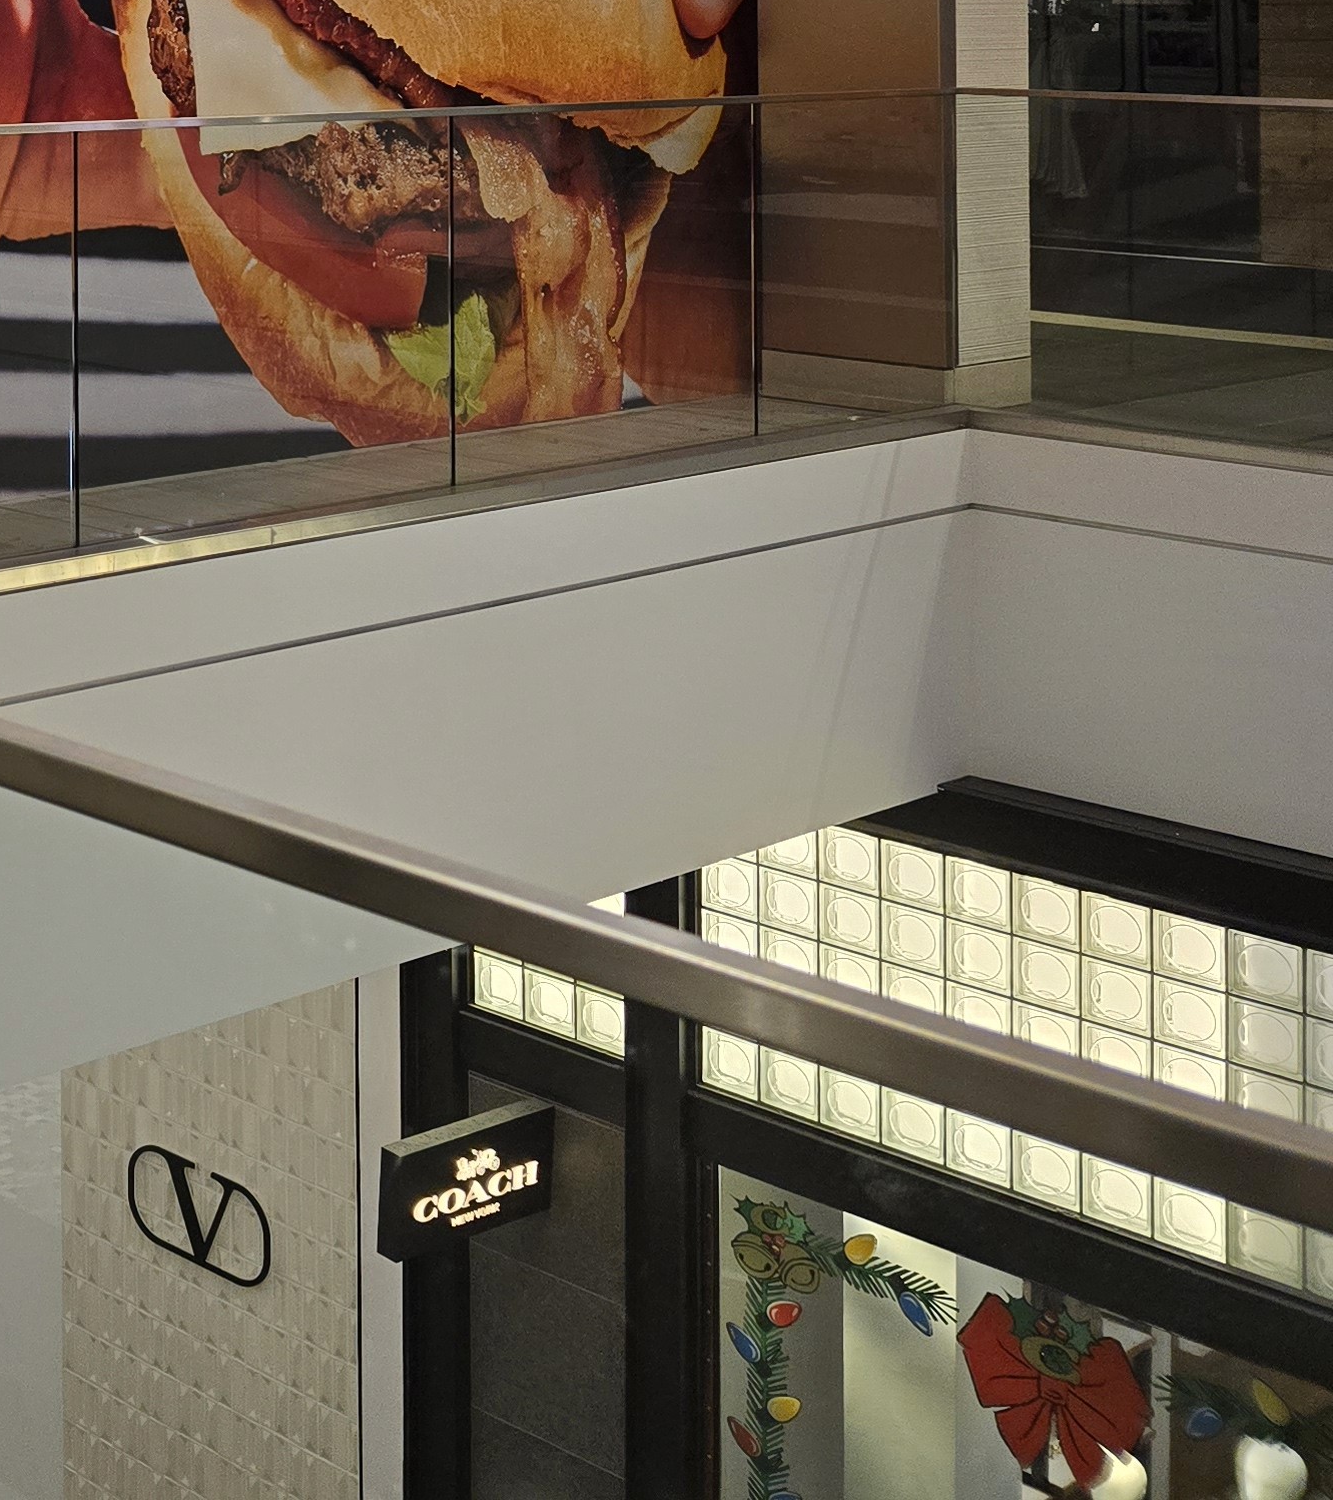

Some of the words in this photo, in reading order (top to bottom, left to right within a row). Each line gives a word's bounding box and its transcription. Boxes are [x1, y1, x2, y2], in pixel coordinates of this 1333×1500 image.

[413, 1160, 539, 1223] COACH
[450, 1210, 475, 1228] NEW
[475, 1202, 501, 1219] YORK
